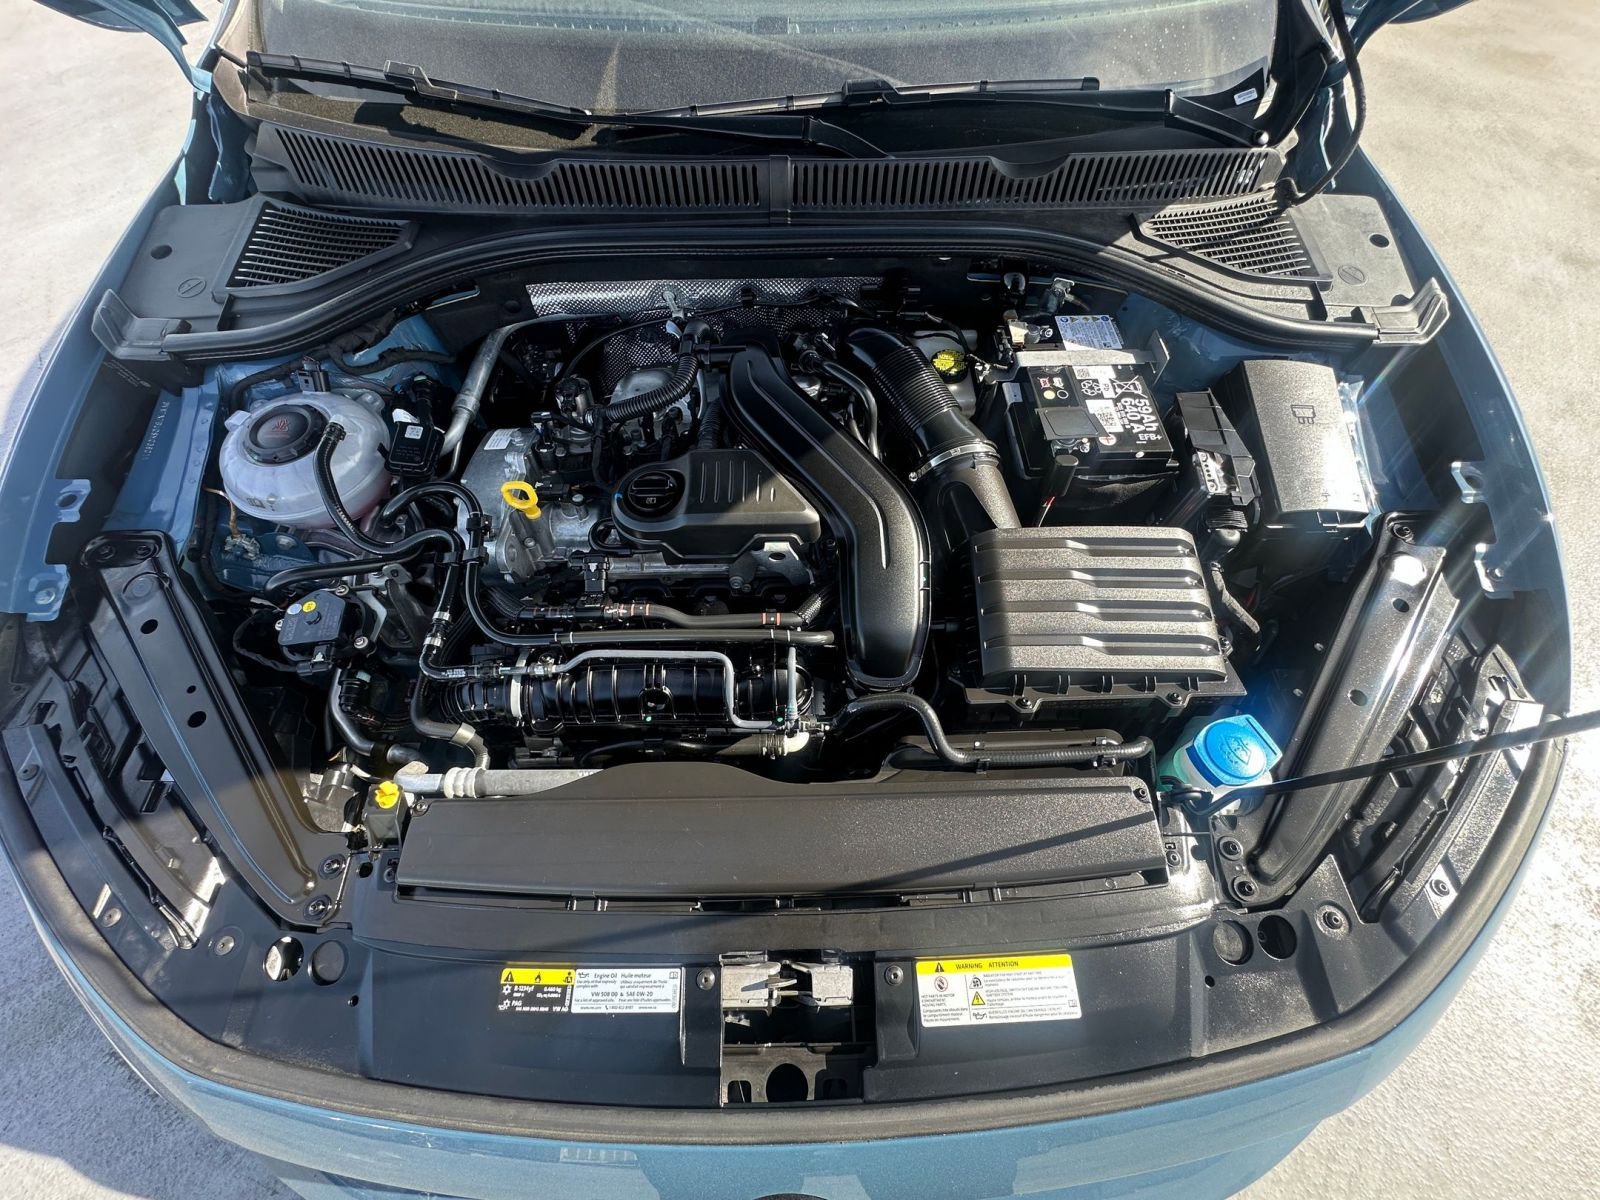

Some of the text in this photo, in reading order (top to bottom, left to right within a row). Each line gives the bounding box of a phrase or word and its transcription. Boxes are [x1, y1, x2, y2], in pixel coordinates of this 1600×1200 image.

[1121, 398, 1140, 420] 640
[1135, 399, 1159, 431] 59Ah
[1130, 423, 1145, 433] A
